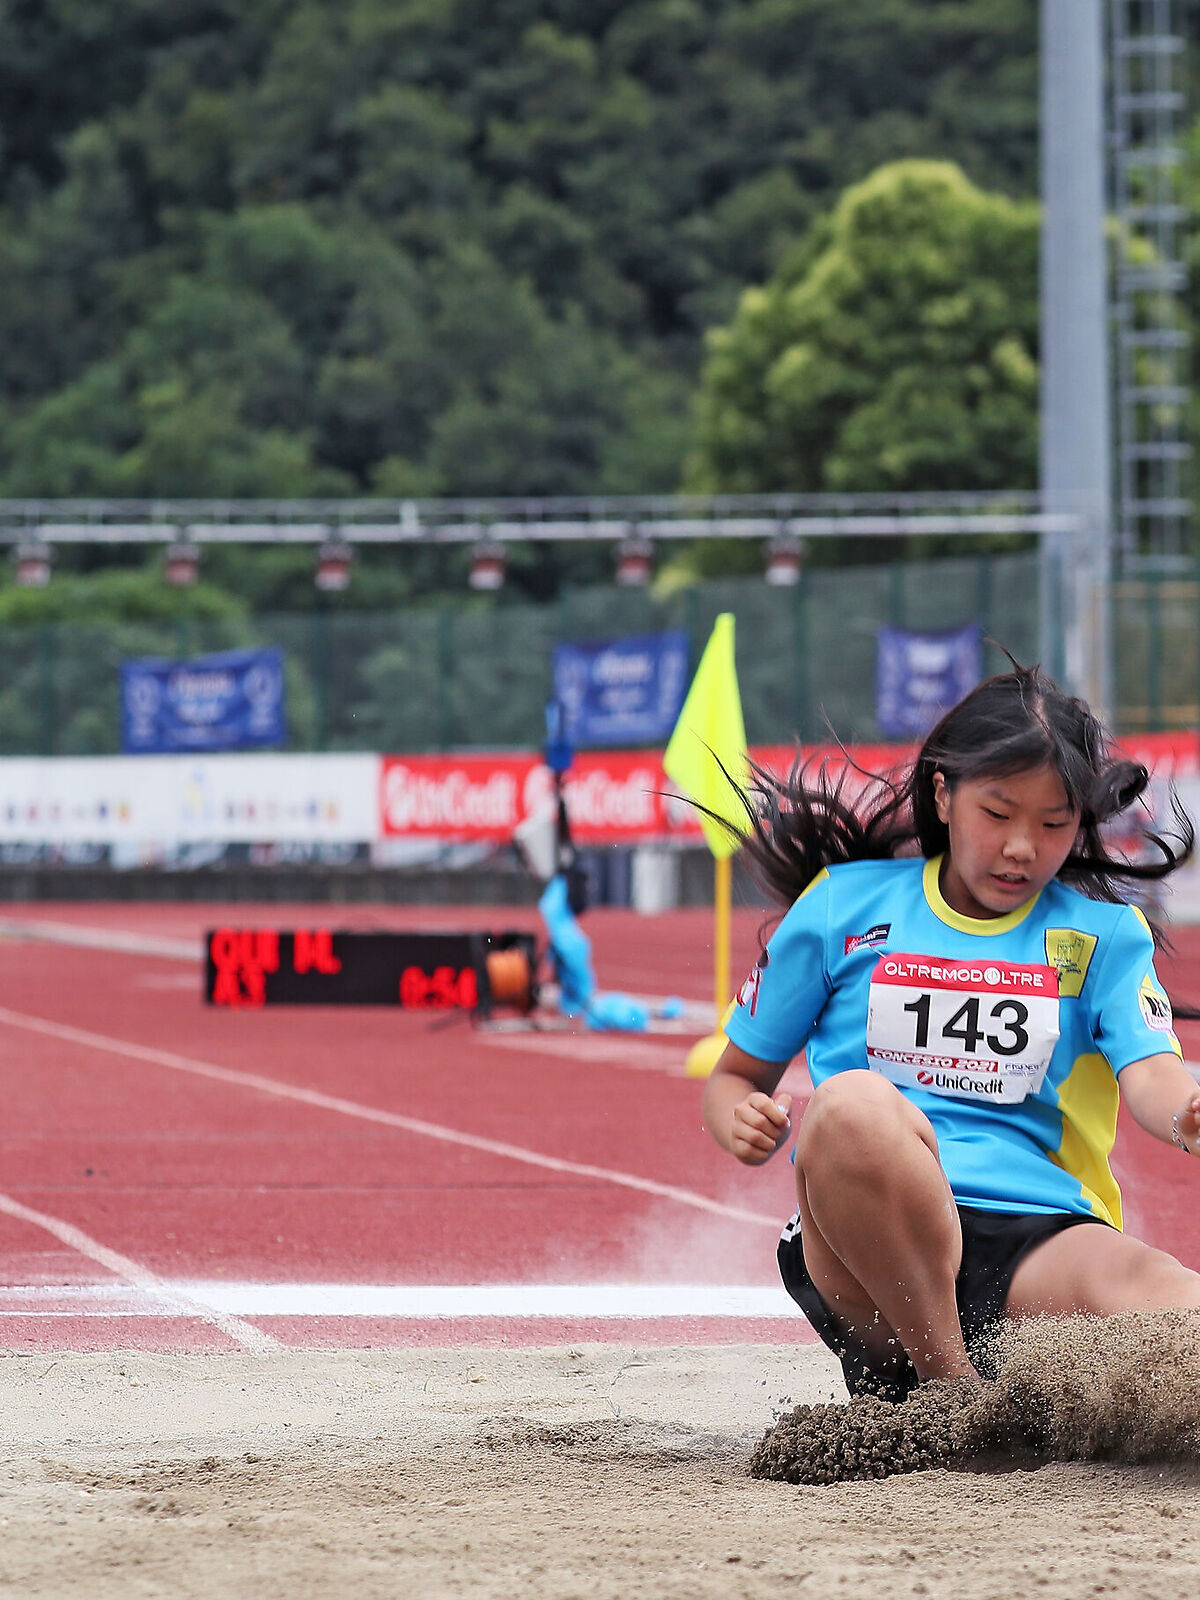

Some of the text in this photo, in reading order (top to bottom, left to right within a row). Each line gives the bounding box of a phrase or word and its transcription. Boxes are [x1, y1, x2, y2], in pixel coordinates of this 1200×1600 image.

[884, 961, 1044, 988] OLTREMODOLTRE
[904, 993, 1029, 1056] 143
[956, 1059, 996, 1073] 2021
[935, 1072, 1004, 1094] UniCredit
